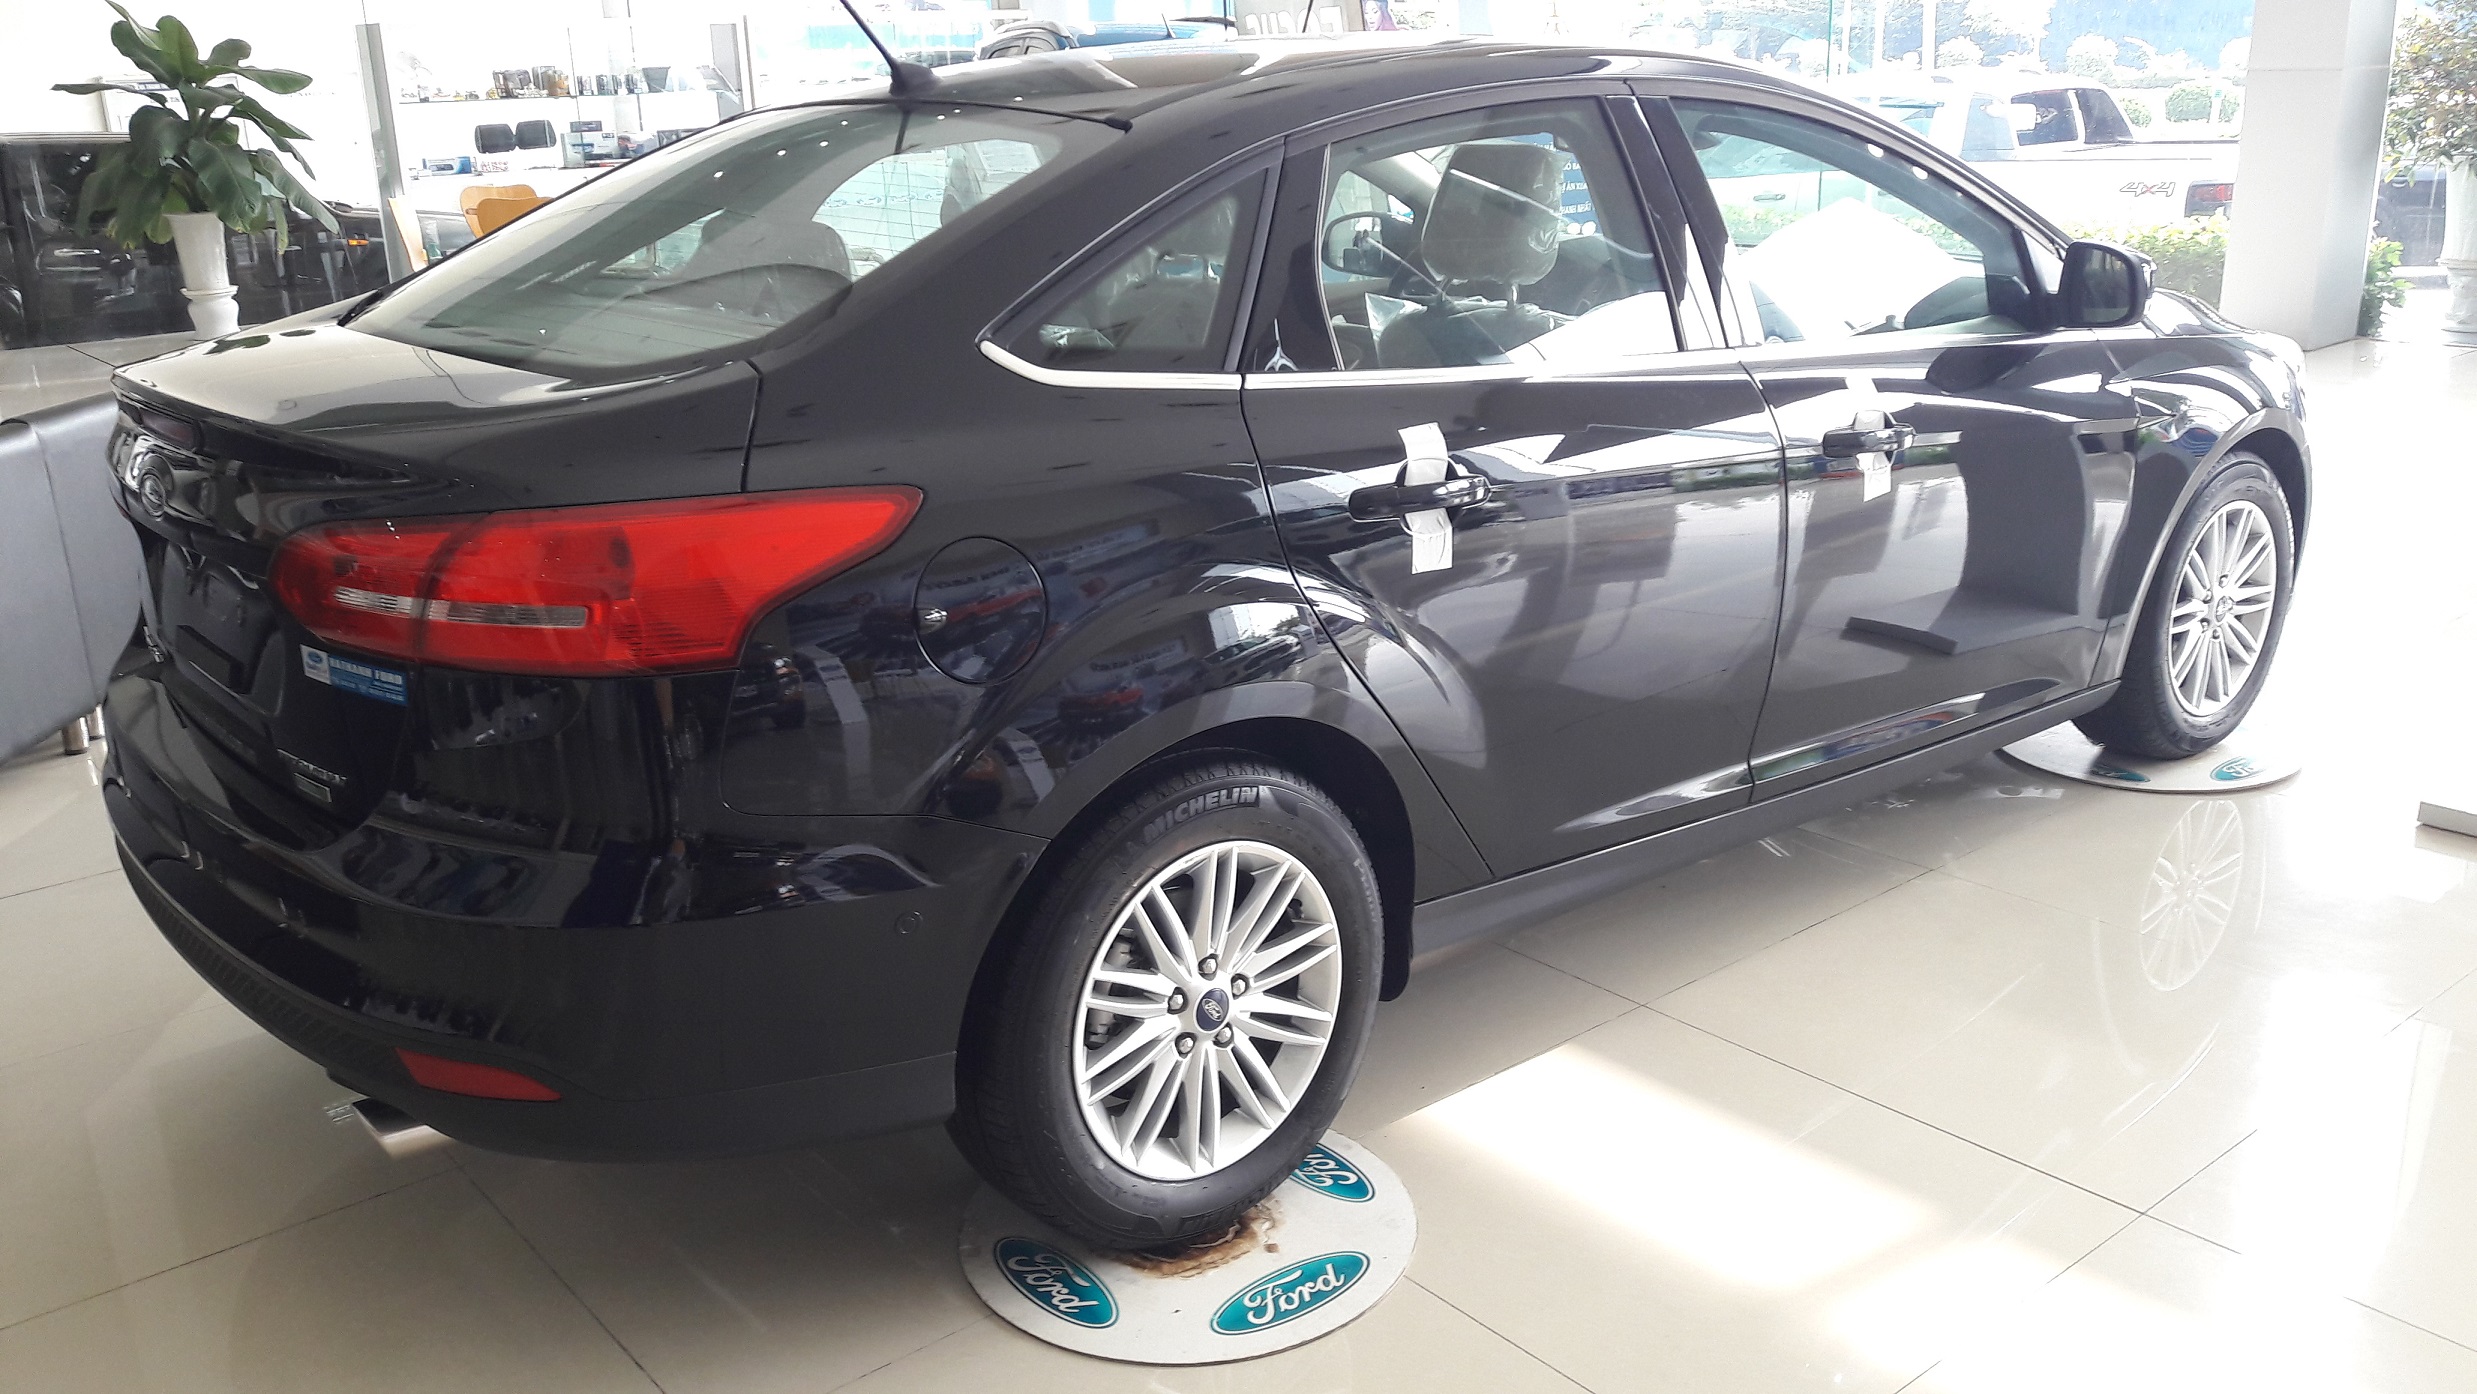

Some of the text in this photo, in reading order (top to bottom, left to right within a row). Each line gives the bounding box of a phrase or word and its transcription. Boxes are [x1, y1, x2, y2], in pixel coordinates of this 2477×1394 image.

[1142, 785, 1260, 842] MICHELIN
[1006, 1253, 1100, 1313] Ford
[1242, 1263, 1346, 1325] Ford
